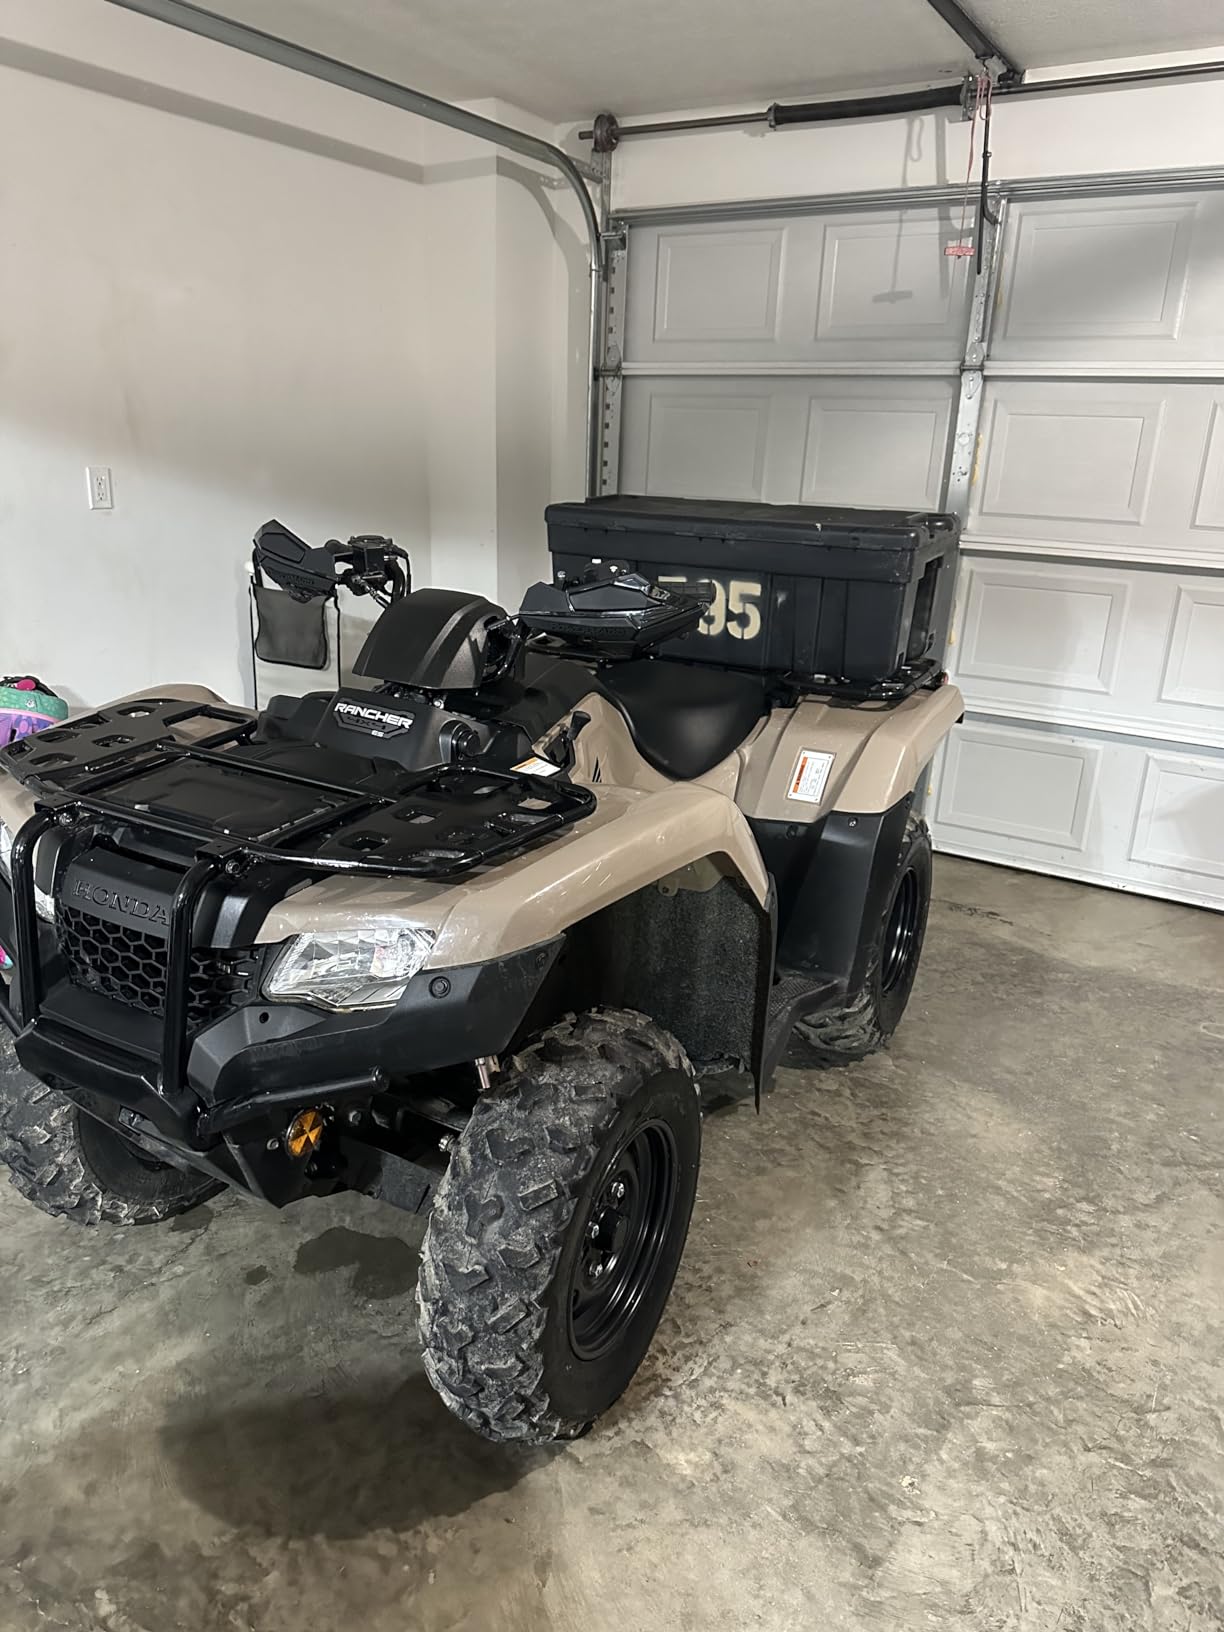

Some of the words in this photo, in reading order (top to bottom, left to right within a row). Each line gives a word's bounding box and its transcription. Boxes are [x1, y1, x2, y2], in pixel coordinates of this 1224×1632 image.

[658, 576, 761, 640] 95
[334, 702, 413, 729] RANCHER
[73, 880, 171, 927] HONDA
